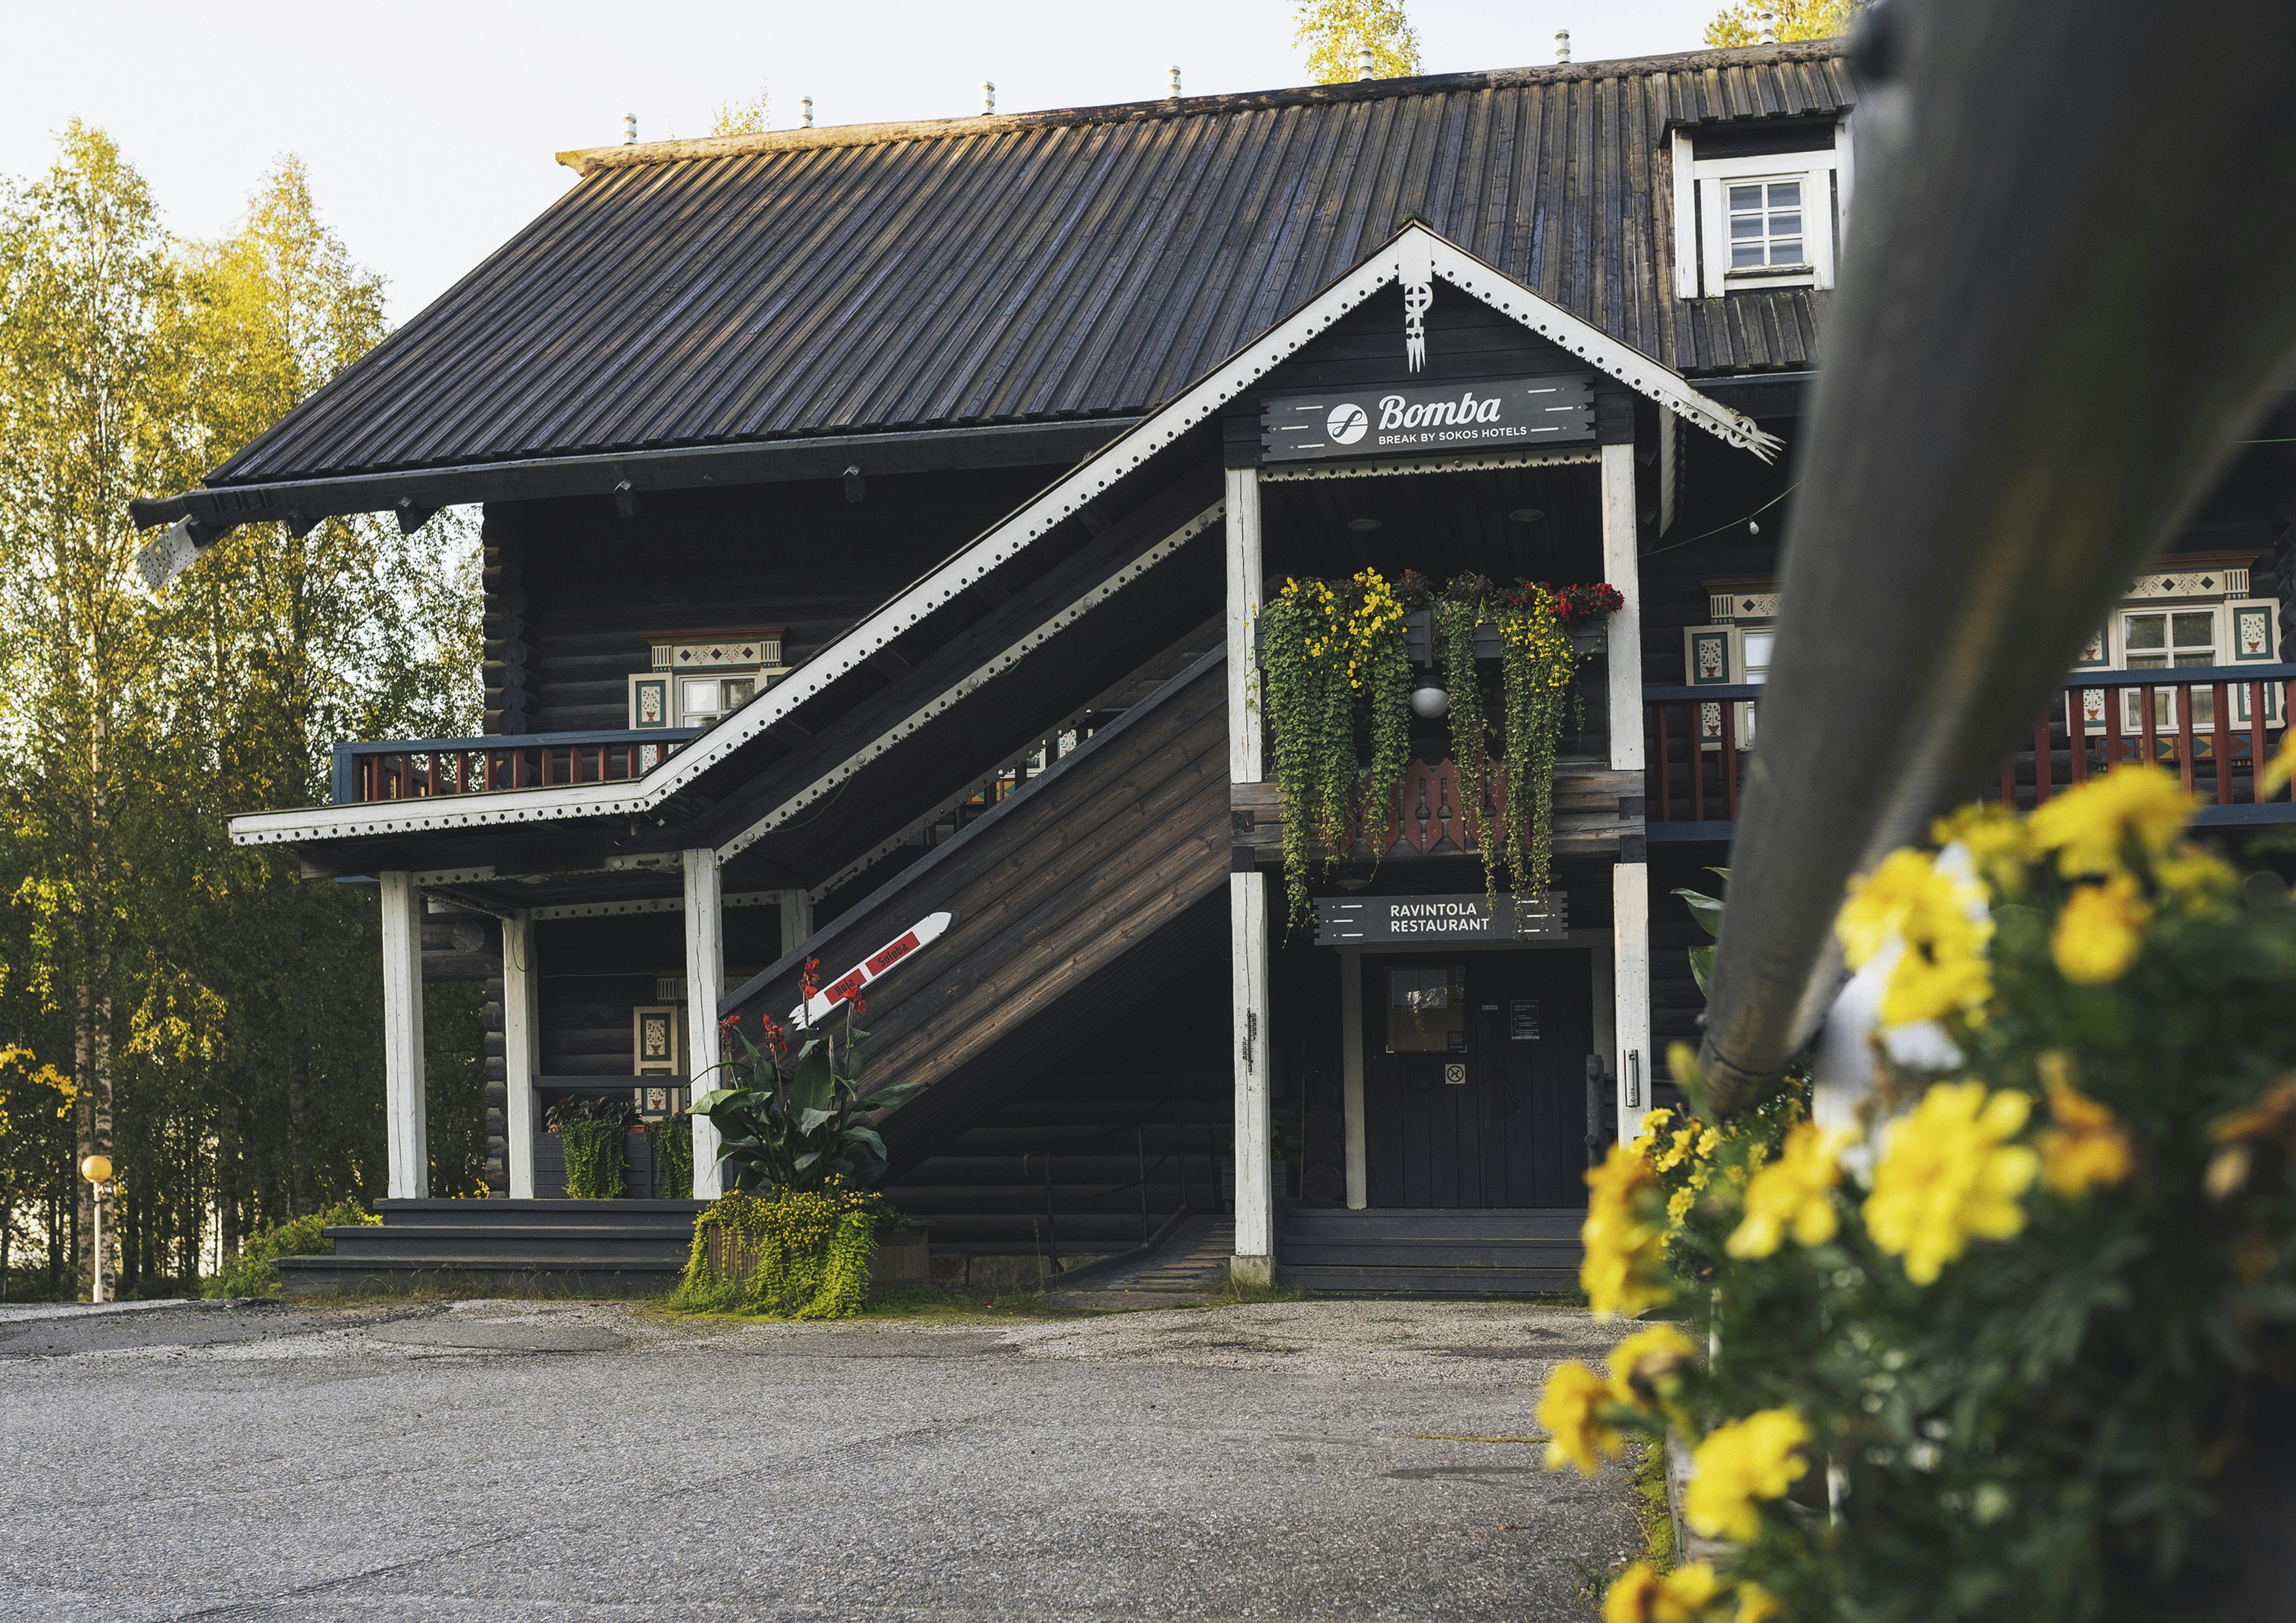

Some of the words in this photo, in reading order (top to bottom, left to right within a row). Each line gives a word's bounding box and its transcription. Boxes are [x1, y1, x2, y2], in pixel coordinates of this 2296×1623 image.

[1378, 392, 1501, 430] Bomba
[1378, 434, 1417, 445] BREAK
[1420, 432, 1436, 442] BY
[1439, 429, 1479, 441] SOKOS
[1481, 426, 1527, 438] HOTELS
[1390, 902, 1477, 917] RAVINTOLA
[1390, 918, 1490, 933] RESTAURANT
